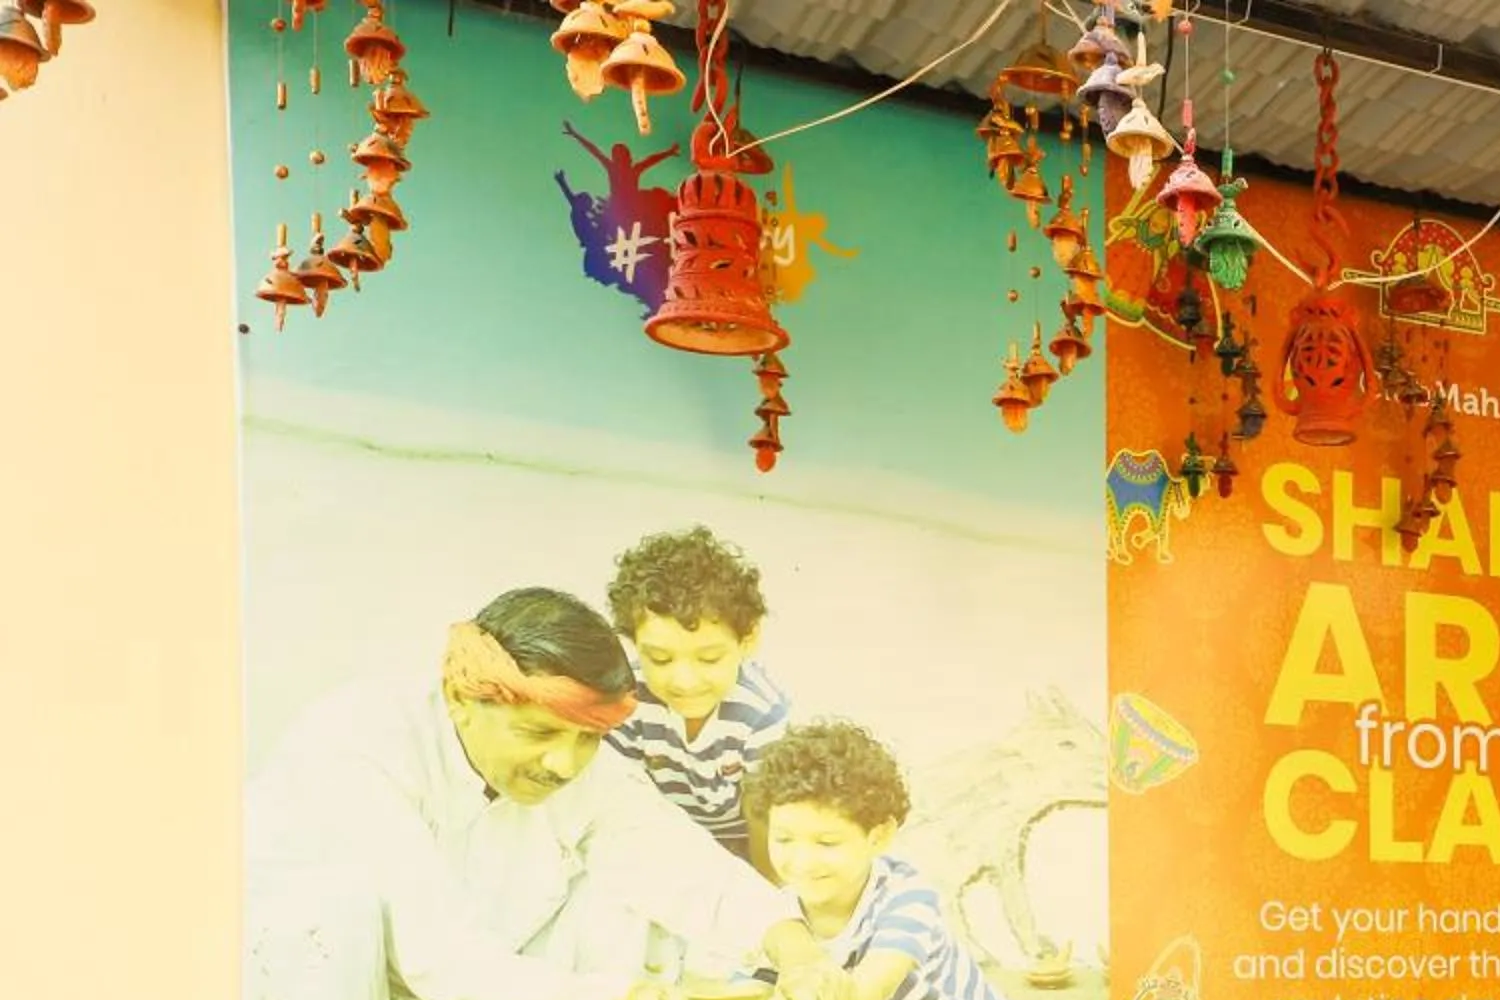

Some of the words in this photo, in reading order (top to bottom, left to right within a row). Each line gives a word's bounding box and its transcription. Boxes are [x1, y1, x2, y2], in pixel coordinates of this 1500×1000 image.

[1258, 900, 1323, 933] Get
[1330, 906, 1410, 942] your
[1232, 948, 1306, 980] and
[1314, 948, 1462, 980] discover
